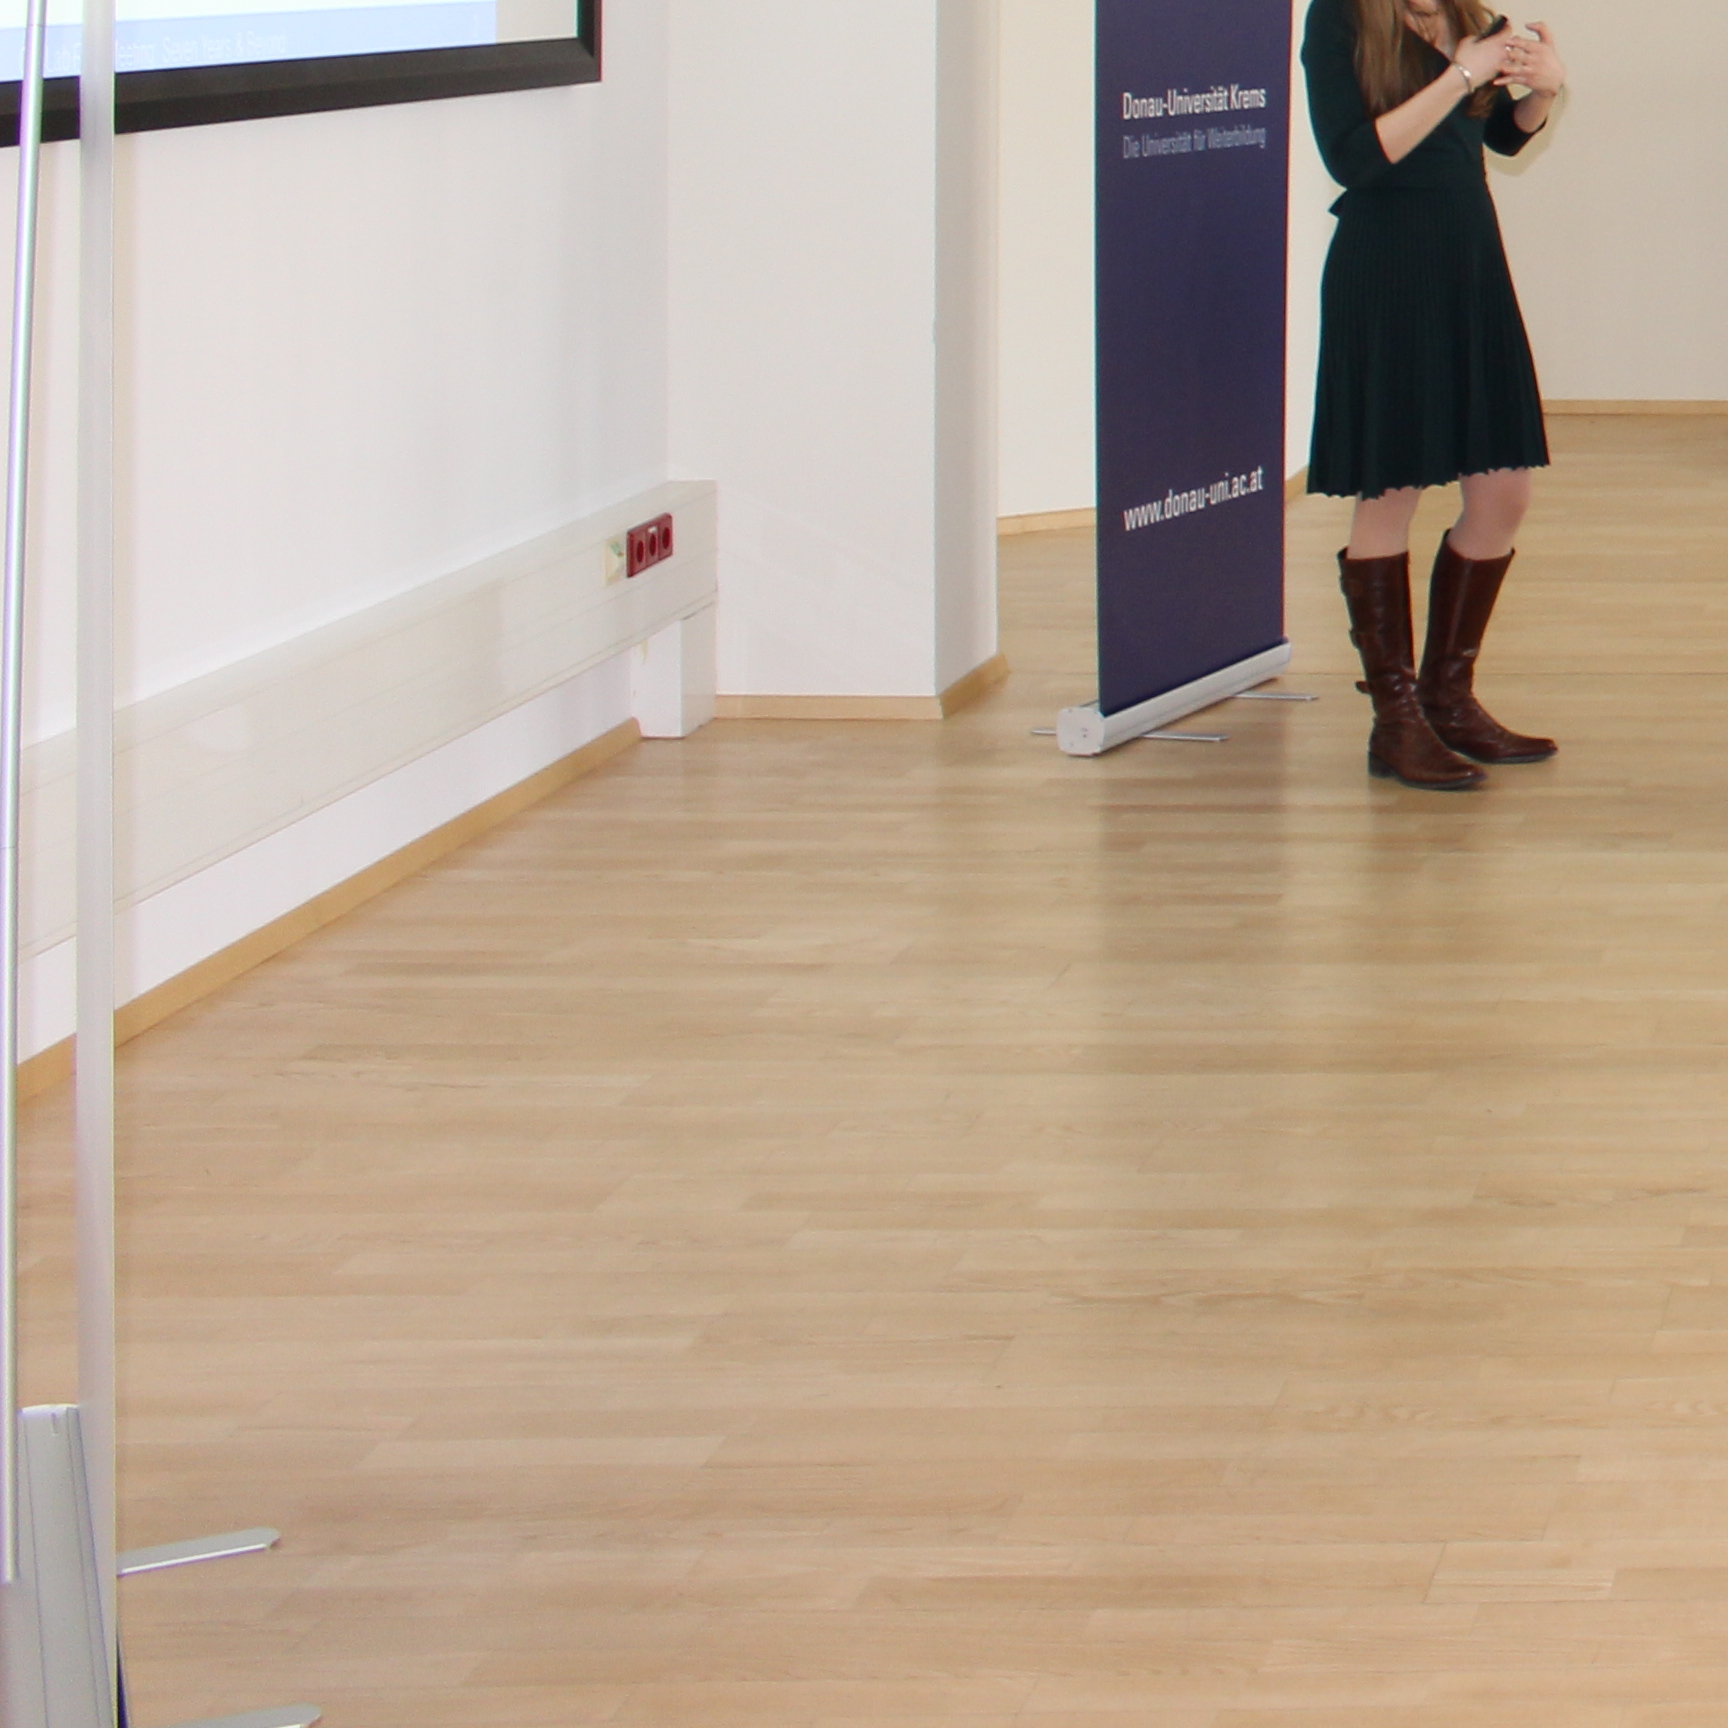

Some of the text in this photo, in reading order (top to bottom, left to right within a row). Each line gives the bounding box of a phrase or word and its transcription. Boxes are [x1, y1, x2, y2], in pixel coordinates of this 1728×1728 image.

[1122, 82, 1267, 121] Donau-Universität Krems
[1122, 122, 1267, 159] Die Universität für Weiterbildung
[1122, 464, 1266, 533] www.donau-uni.ac.at
